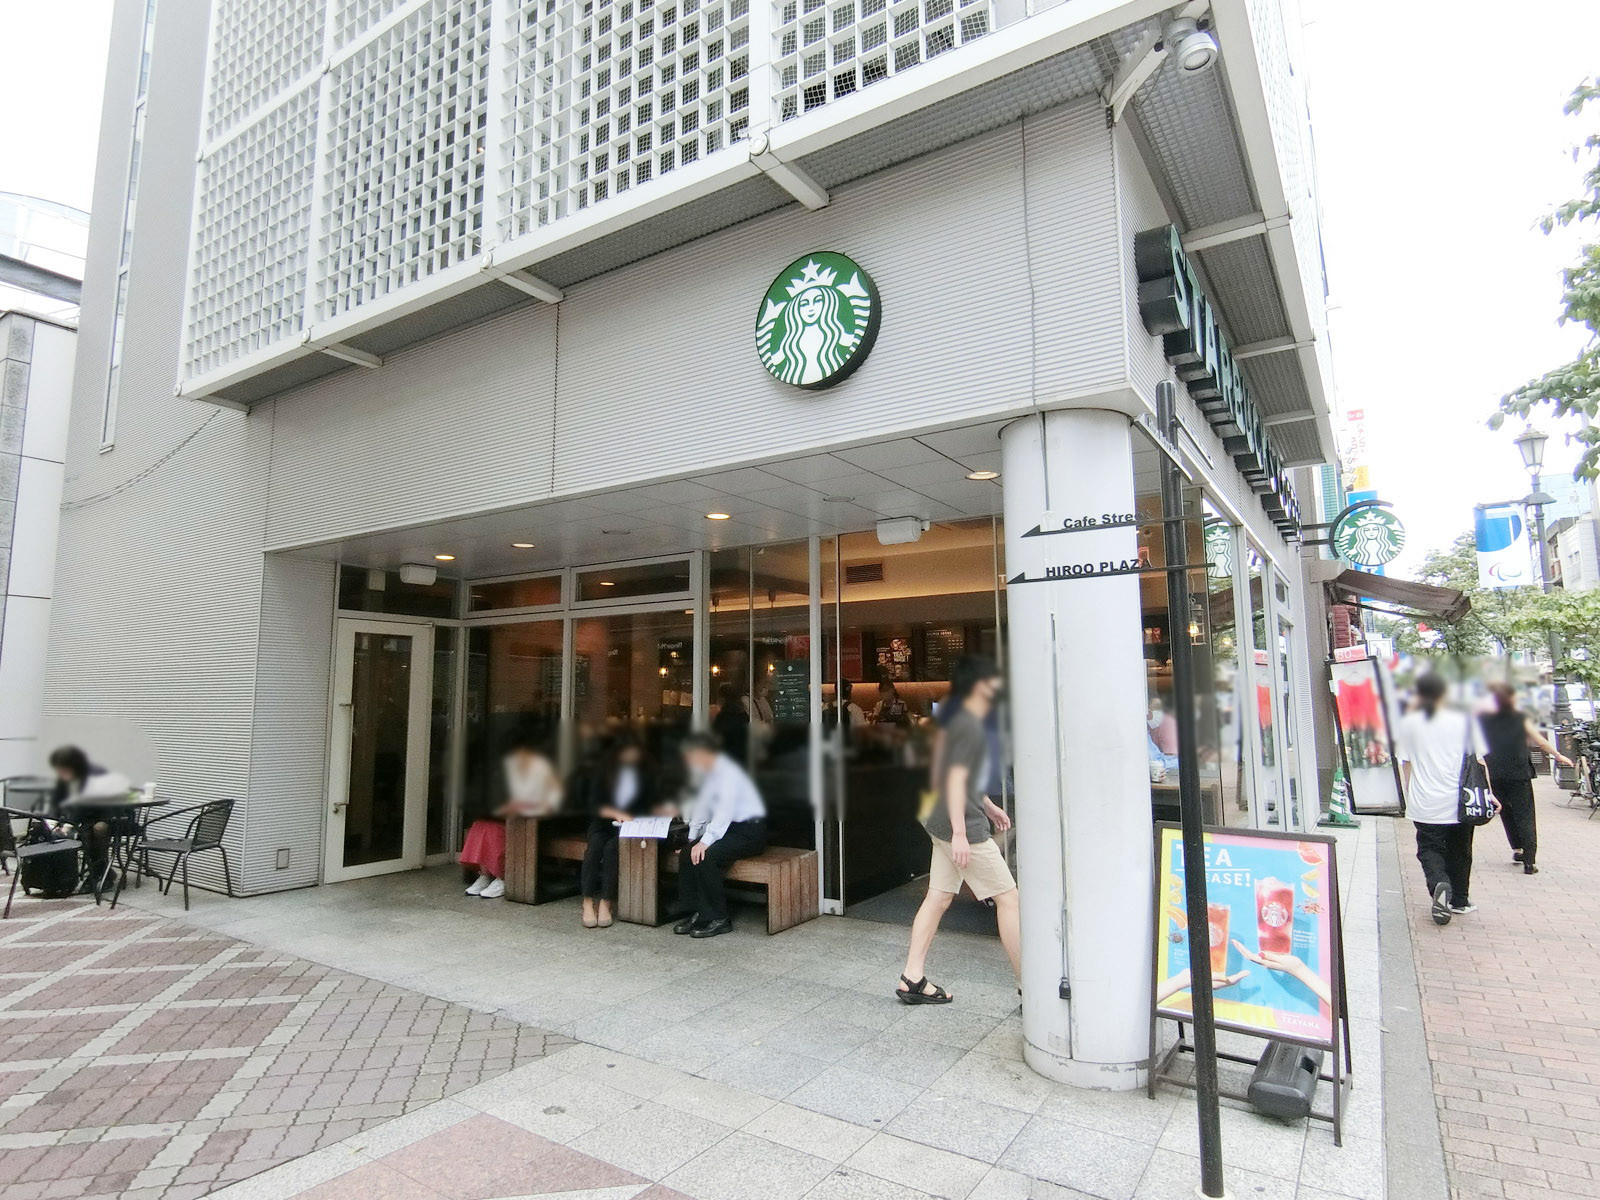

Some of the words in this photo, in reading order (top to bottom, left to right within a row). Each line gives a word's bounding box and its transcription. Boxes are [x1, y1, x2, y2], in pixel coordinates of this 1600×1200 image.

[1063, 515, 1097, 529] Cafe
[1046, 563, 1094, 578] HIROO
[1099, 558, 1152, 573] PLAZA
